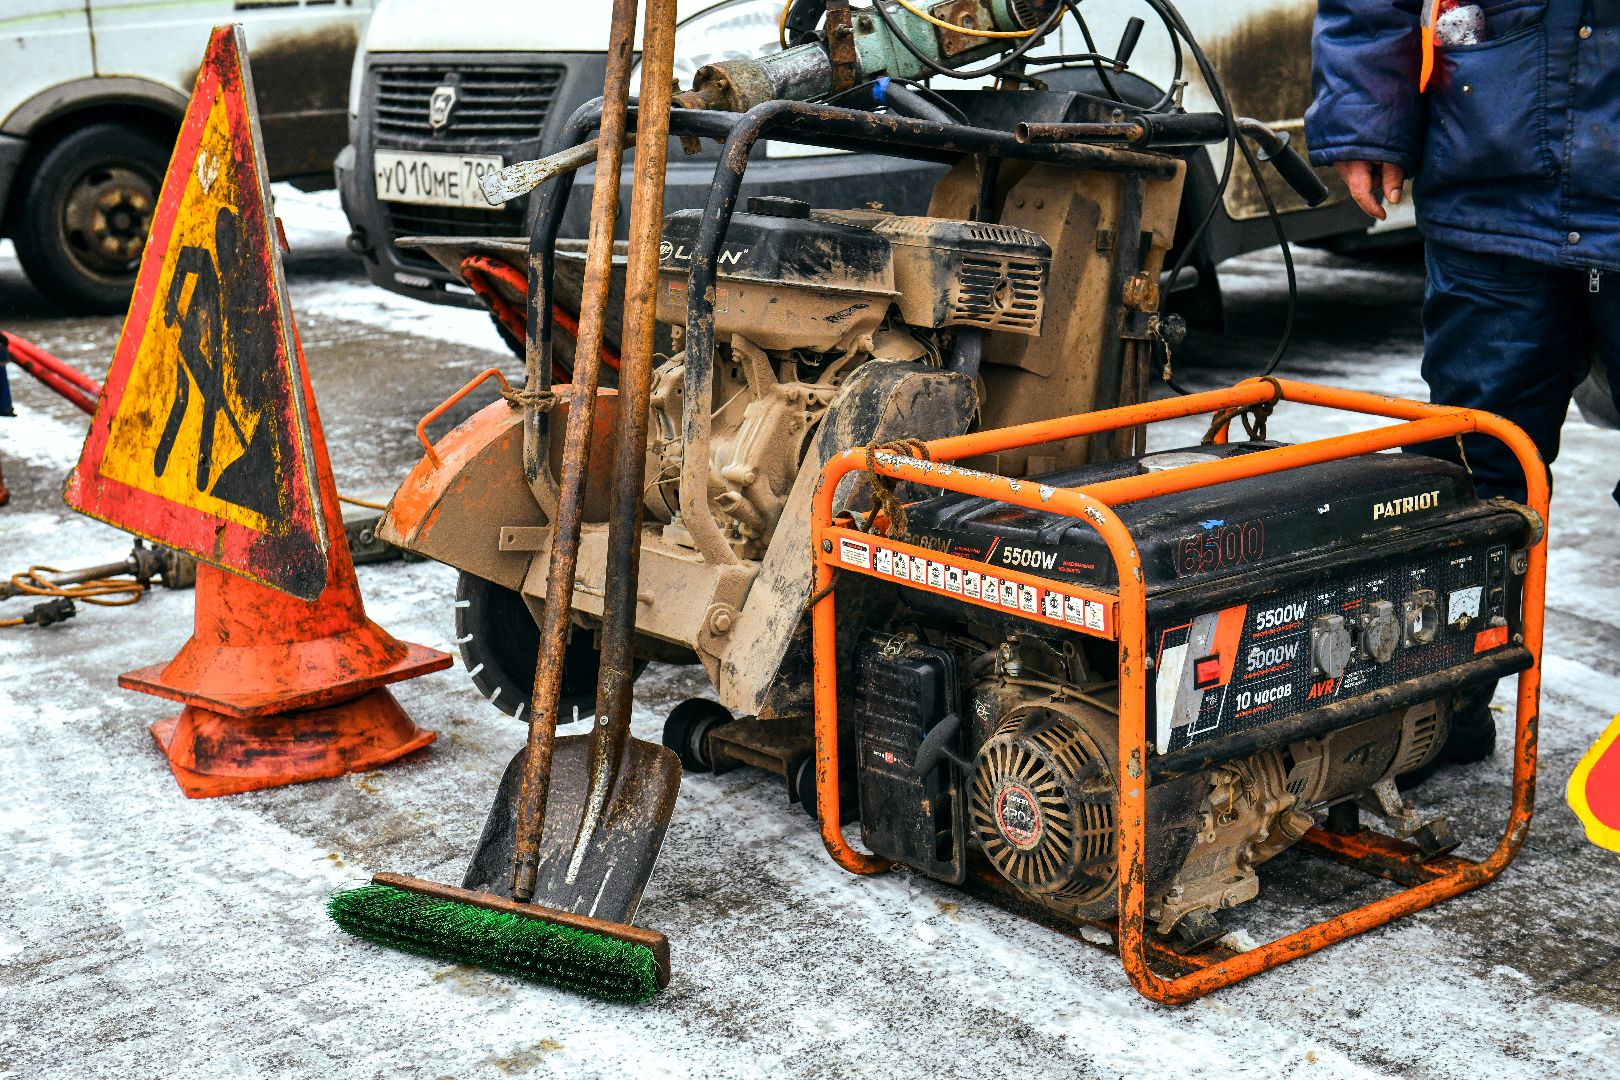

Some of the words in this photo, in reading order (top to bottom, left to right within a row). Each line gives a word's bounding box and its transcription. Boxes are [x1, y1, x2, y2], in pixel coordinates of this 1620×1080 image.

[1373, 490, 1440, 520] PATRIOT
[1002, 546, 1058, 570] 5500W
[1178, 519, 1265, 579] 6500
[1256, 601, 1308, 630] 5500W
[1246, 641, 1300, 672] 5000W
[1235, 691, 1251, 712] 10
[1307, 679, 1335, 701] AVR
